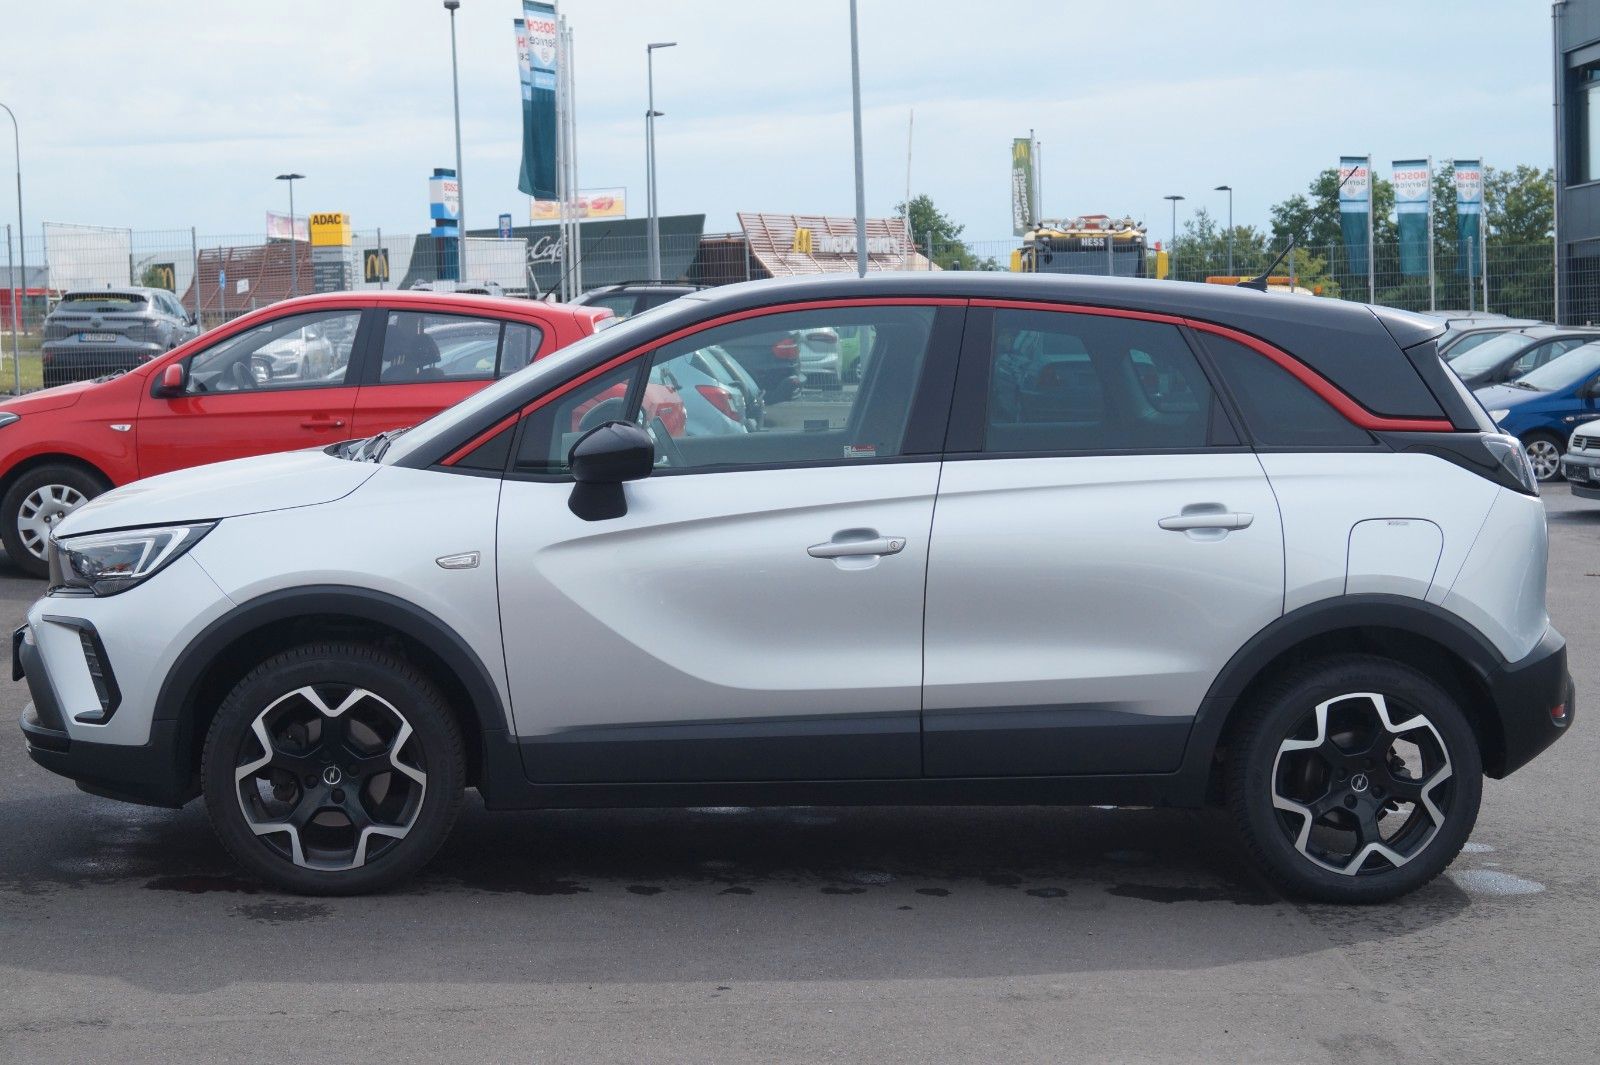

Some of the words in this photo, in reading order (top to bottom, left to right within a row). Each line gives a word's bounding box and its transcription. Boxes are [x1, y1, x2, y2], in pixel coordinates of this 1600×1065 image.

[444, 182, 459, 191] BOSC
[312, 214, 342, 225] ADAC
[1081, 237, 1105, 246] HESS
[527, 236, 567, 264] Café
